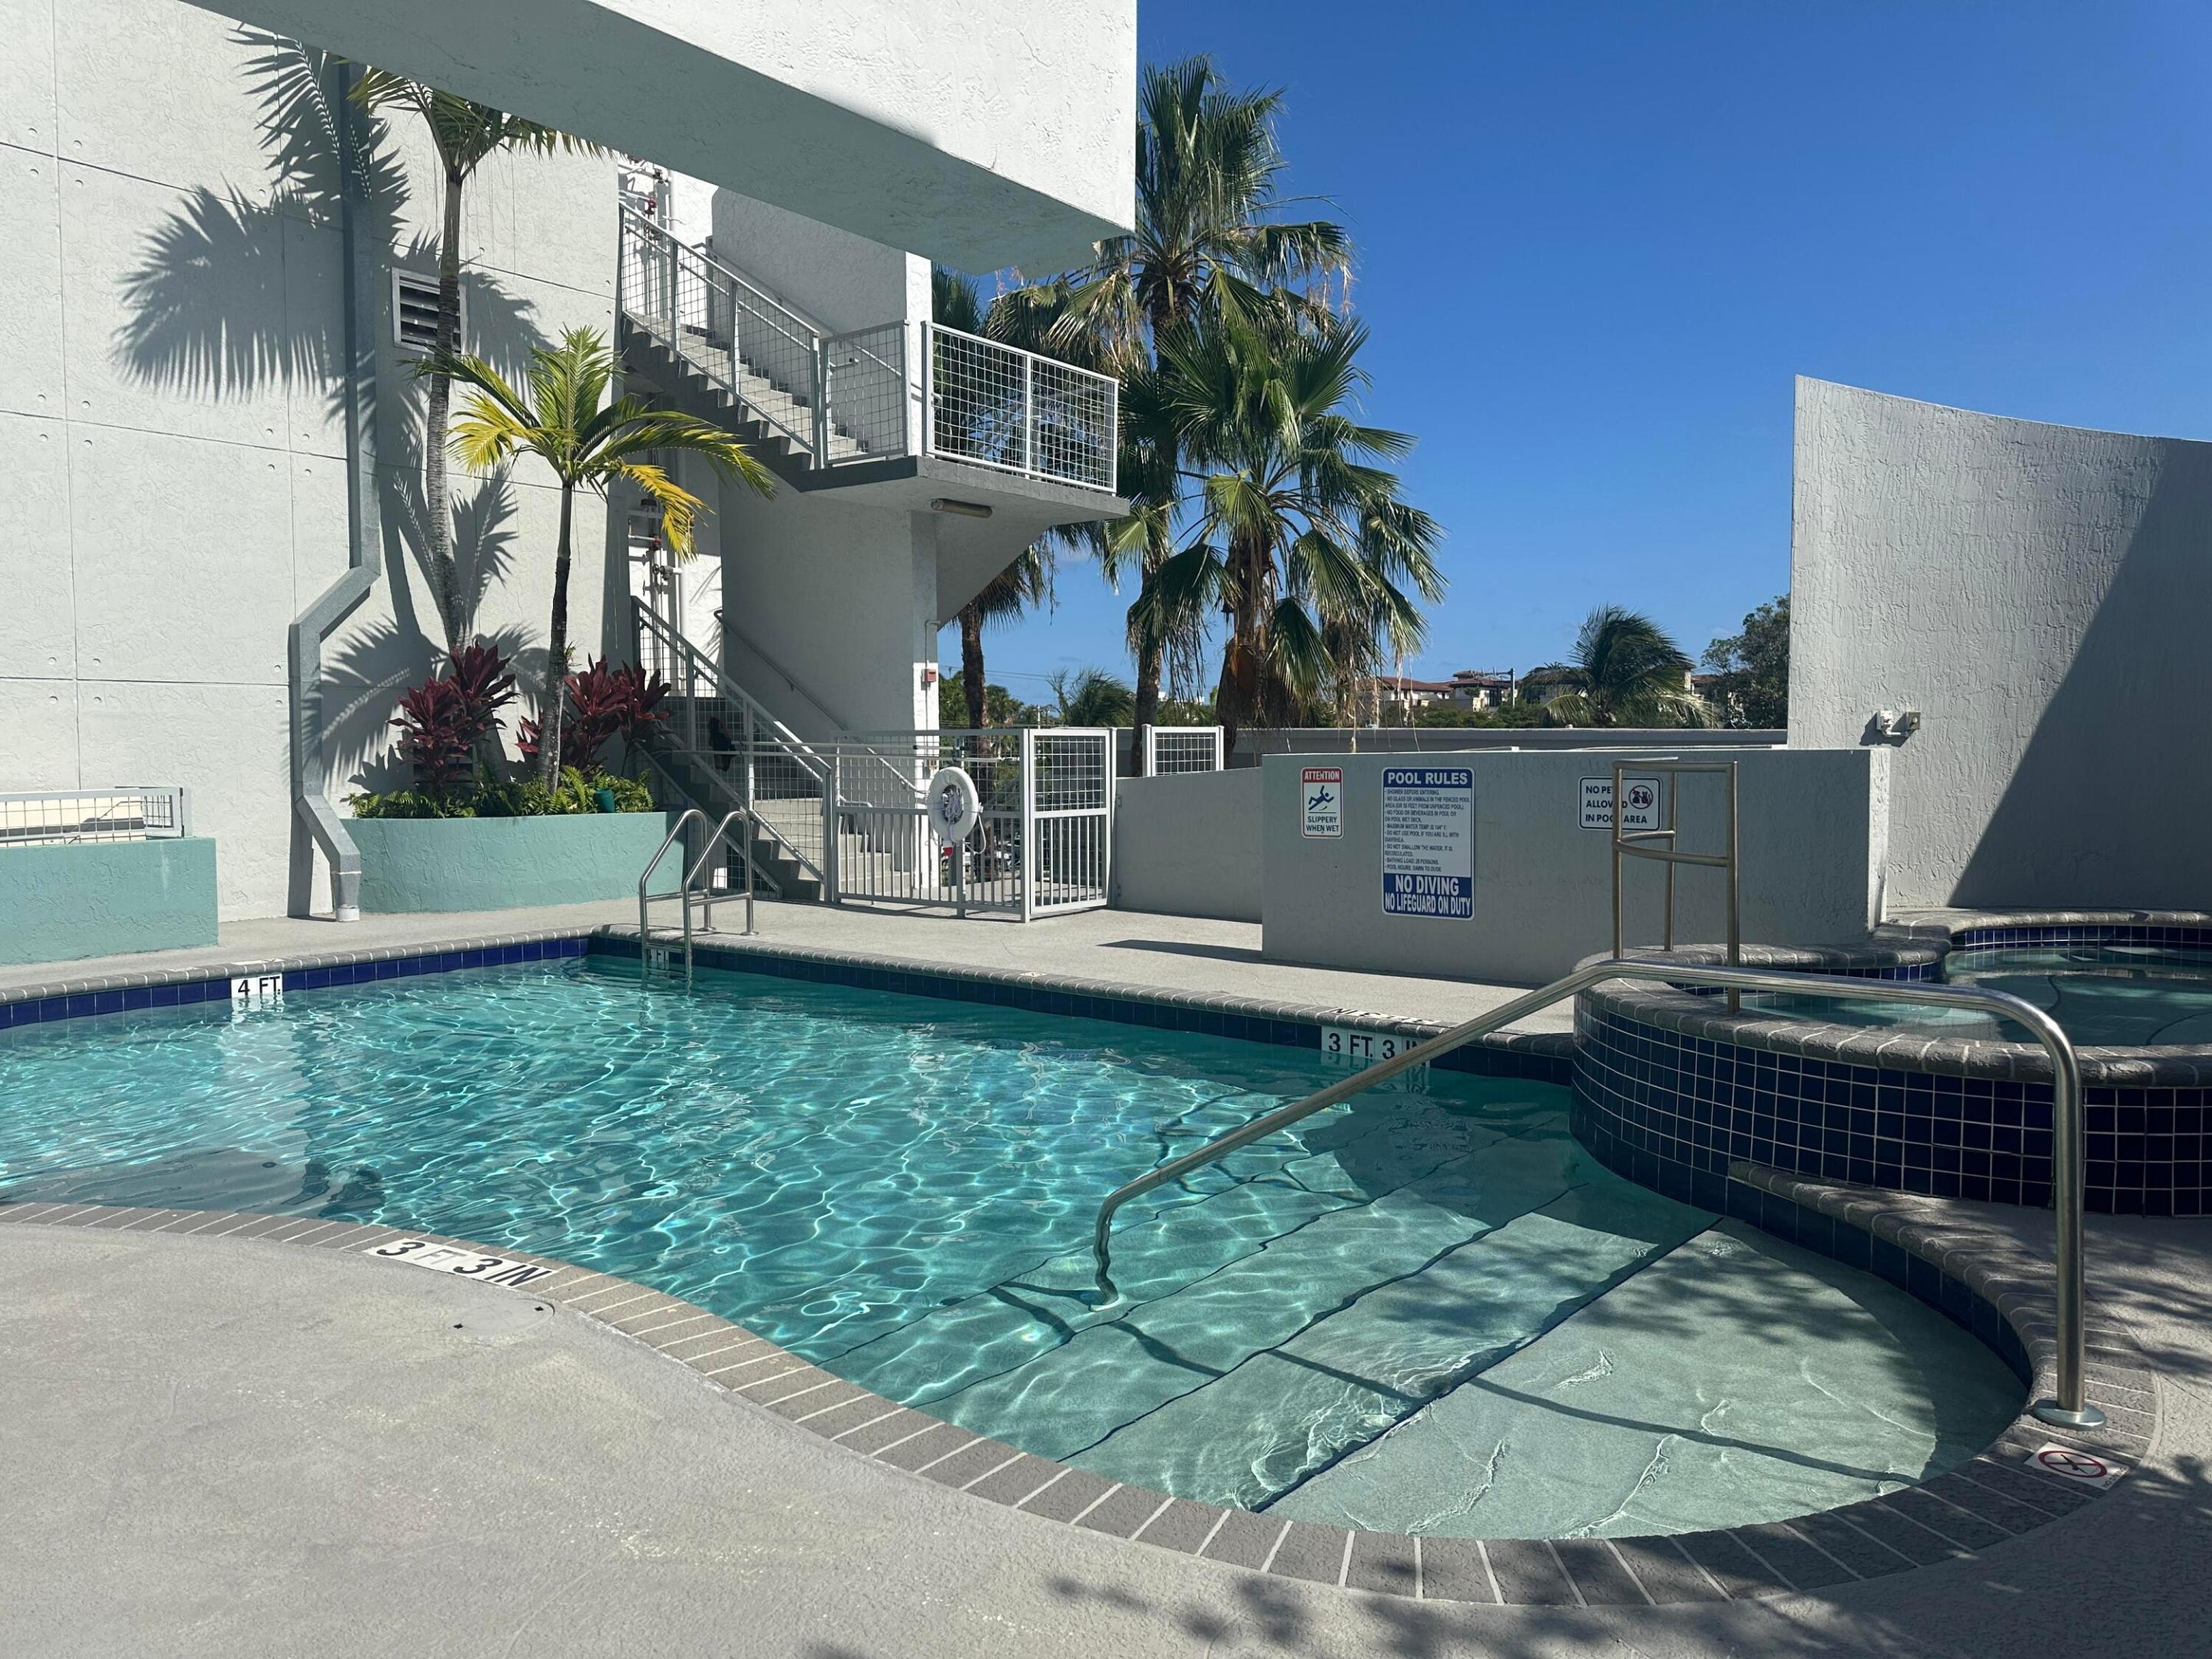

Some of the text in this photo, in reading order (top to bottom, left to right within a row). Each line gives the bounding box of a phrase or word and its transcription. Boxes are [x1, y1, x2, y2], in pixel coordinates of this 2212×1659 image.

[1304, 770, 1339, 780] ATTENTION
[1388, 772, 1468, 785] POOL RULES
[1586, 786, 1599, 794] NO
[1586, 800, 1628, 809] ALLOD
[1597, 814, 1615, 823] PO
[1624, 815, 1647, 823] AREA
[1396, 875, 1459, 896] NO DIVING
[1385, 892, 1471, 916] NO LIFEGUARD ON DUTY
[238, 979, 250, 996] 4
[1329, 1032, 1341, 1052] 3
[1349, 1034, 1373, 1058] FT.
[1382, 1039, 1396, 1060] 3
[376, 1241, 552, 1287] 3 FT 3 IN
